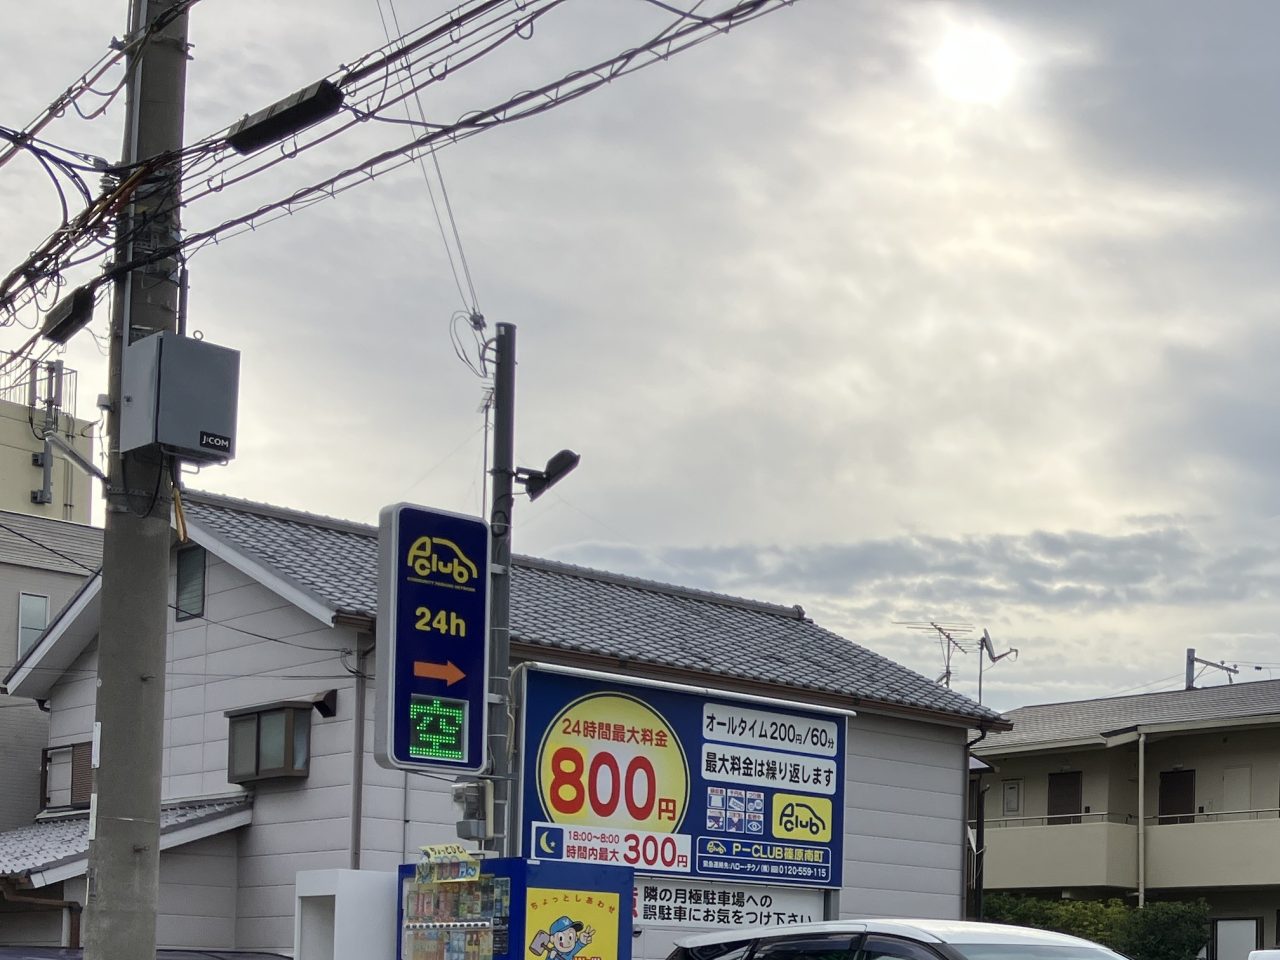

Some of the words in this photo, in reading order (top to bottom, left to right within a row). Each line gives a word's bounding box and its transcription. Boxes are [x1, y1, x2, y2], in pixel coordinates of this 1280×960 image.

[415, 606, 466, 638] 24h
[410, 700, 462, 758] 空
[562, 718, 668, 747] 24時間最大料金
[550, 747, 677, 821] 800円
[705, 752, 834, 787] 最大料金は繰り返します
[566, 845, 620, 862] 時間内最大
[623, 833, 688, 868] 300円
[780, 865, 827, 877] 0120-559-115
[530, 894, 616, 914] ちょっとしあわせ
[644, 886, 773, 908] 隣の月極駐車場への
